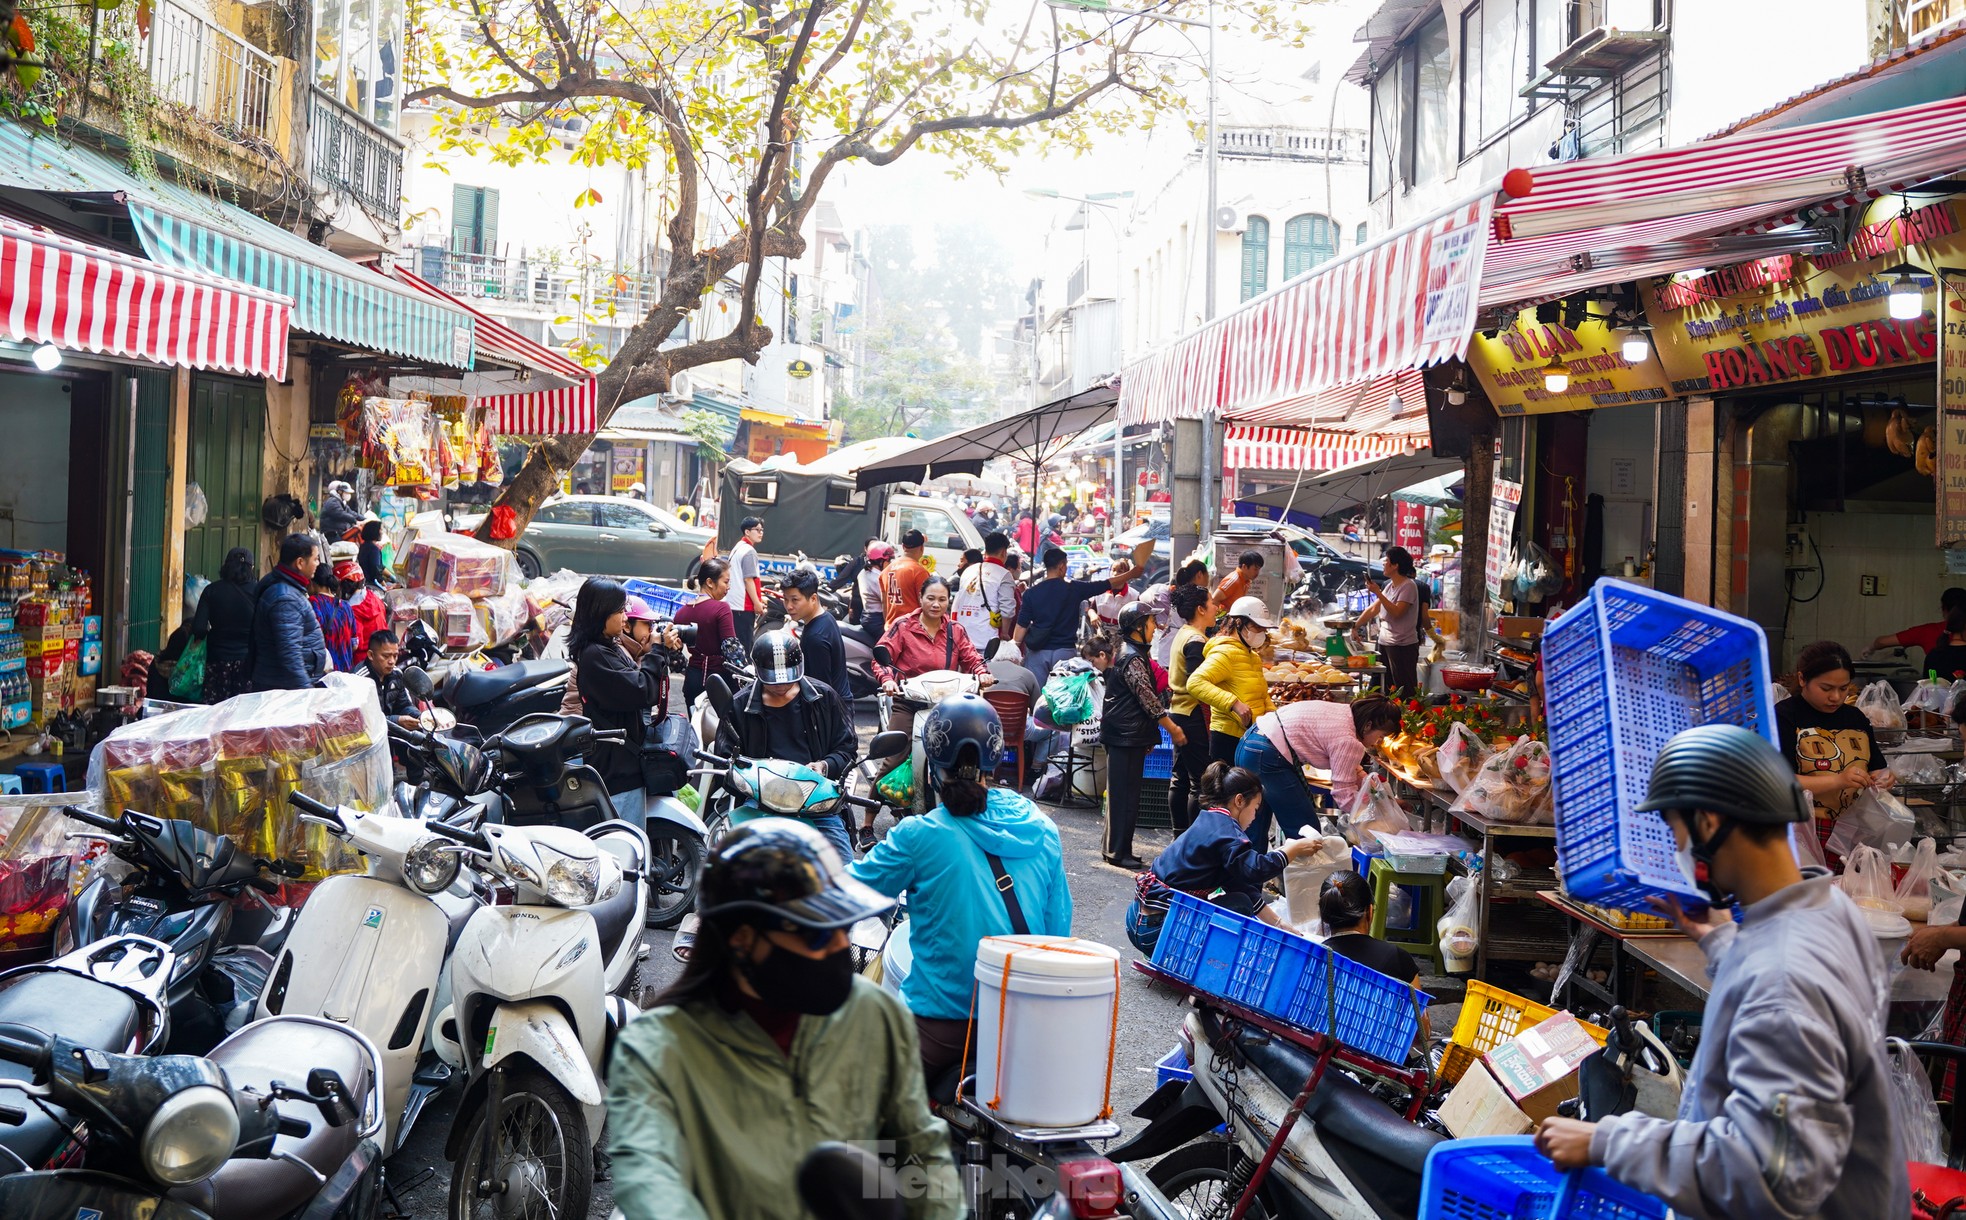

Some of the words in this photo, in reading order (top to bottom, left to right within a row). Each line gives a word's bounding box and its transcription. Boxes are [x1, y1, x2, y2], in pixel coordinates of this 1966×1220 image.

[1685, 319, 1714, 339] Nhận
[1766, 299, 1790, 323] một
[1792, 292, 1822, 314] món
[1526, 323, 1583, 358] LAN
[1702, 331, 1818, 388] HOÀNG
[130, 898, 159, 911] HONDA
[509, 912, 541, 921] HONDA
